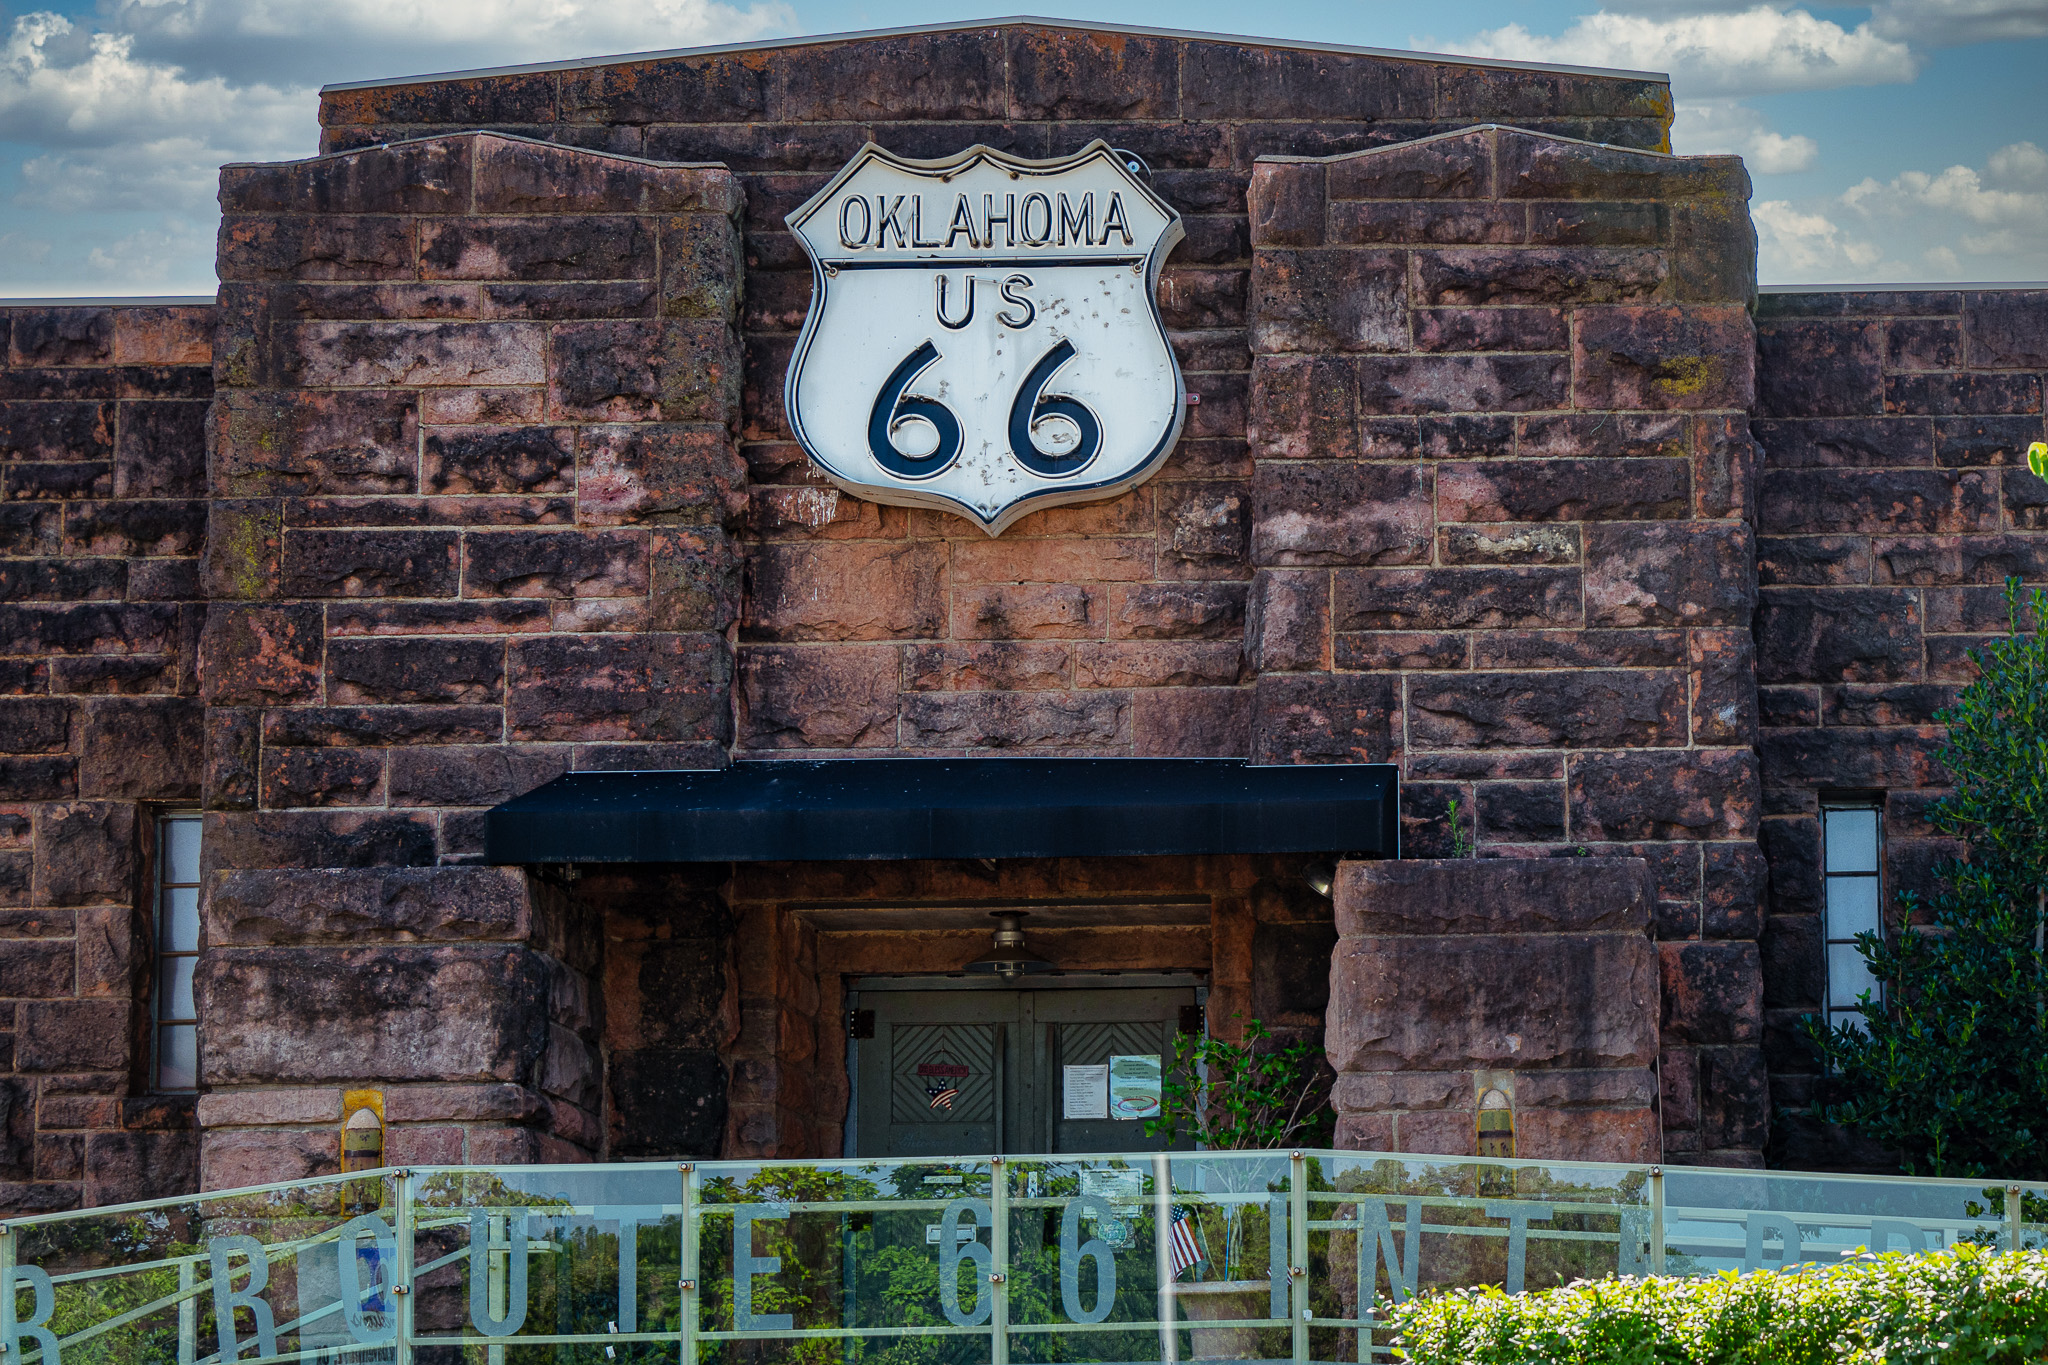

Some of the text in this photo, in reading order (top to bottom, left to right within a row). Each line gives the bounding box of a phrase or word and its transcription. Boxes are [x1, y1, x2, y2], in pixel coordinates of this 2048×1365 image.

[839, 190, 1134, 249] OKLAHOMA
[934, 272, 1036, 331] US
[866, 337, 1104, 480] 66
[209, 1203, 794, 1364] ROUTE
[939, 1197, 1117, 1327] 66
